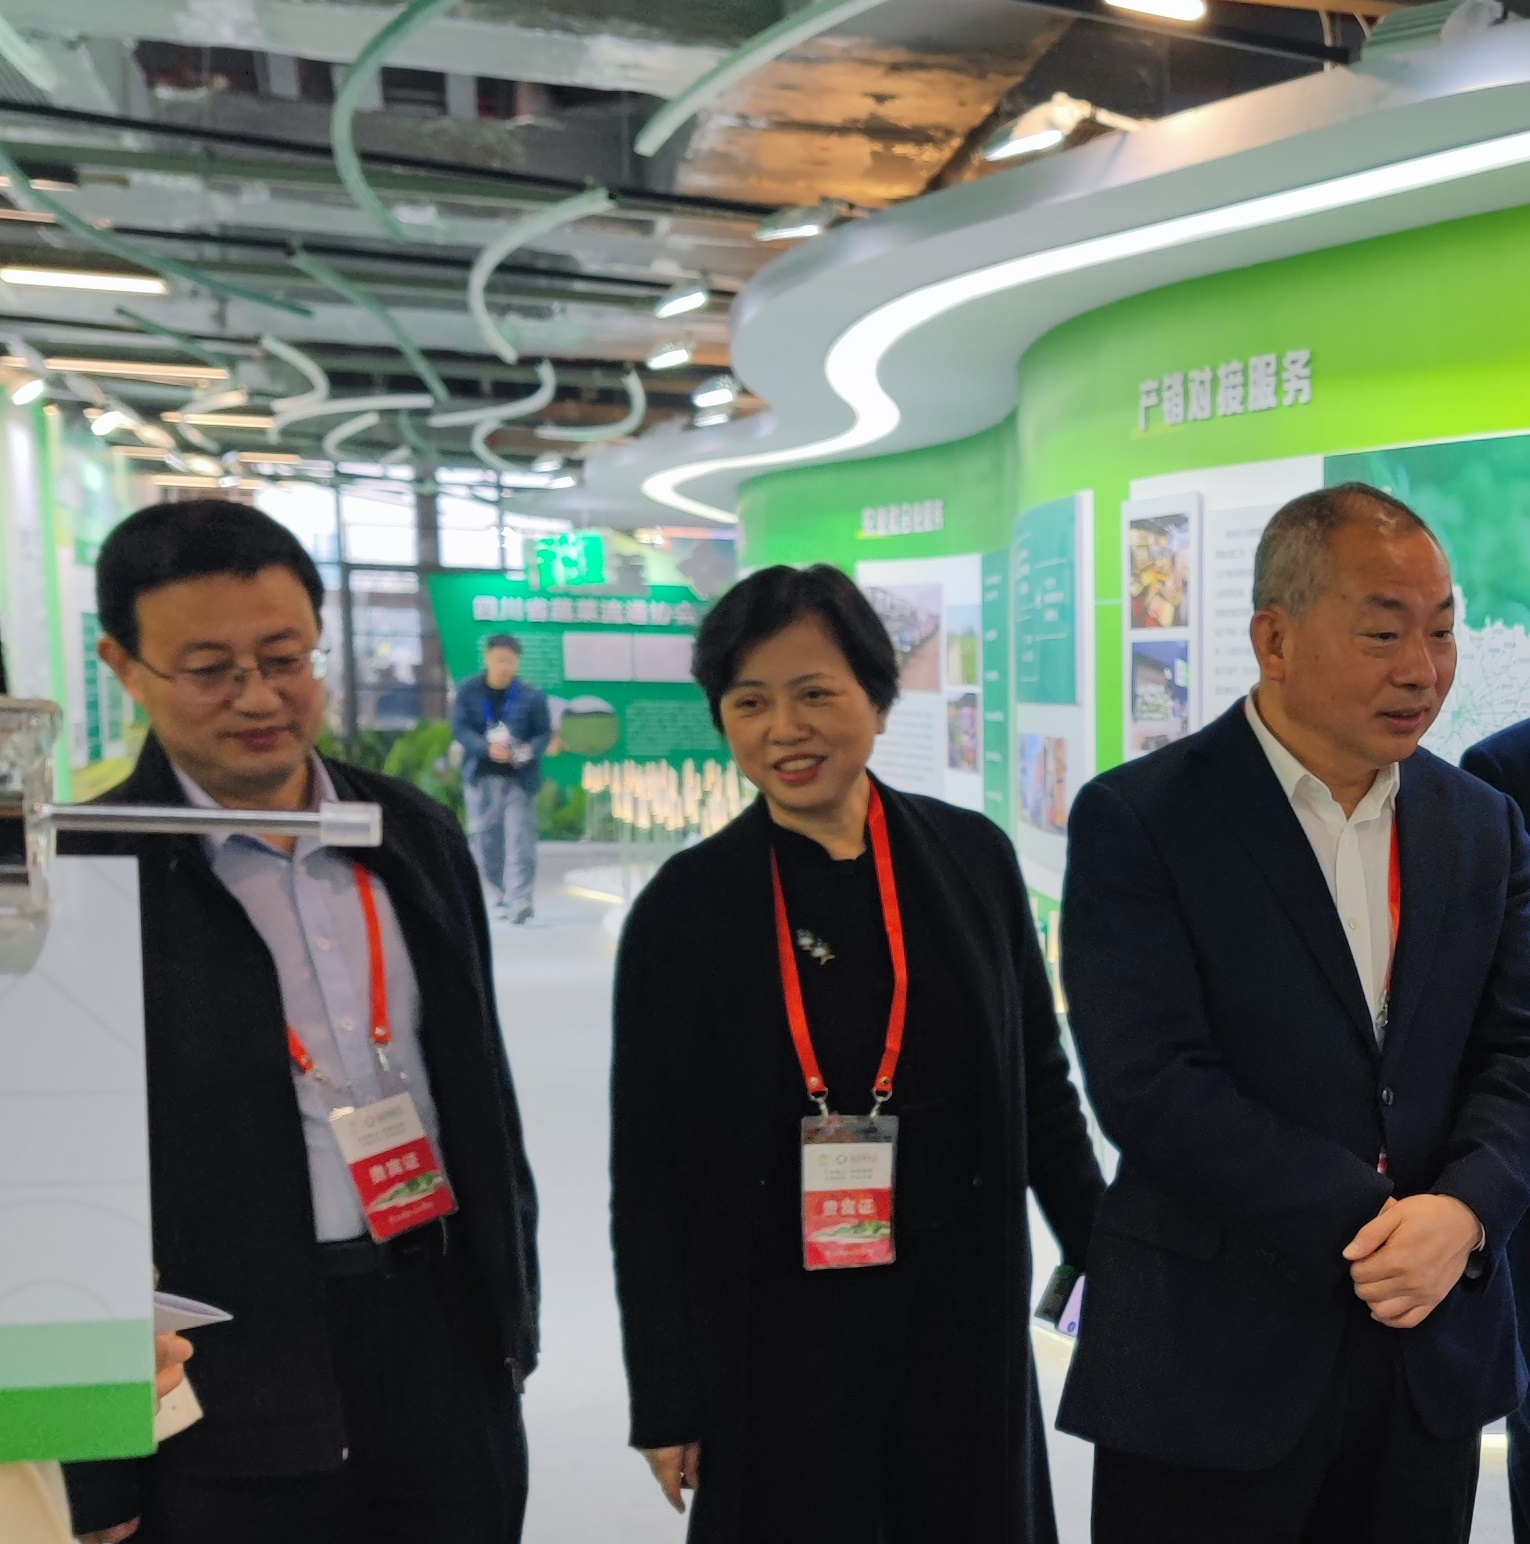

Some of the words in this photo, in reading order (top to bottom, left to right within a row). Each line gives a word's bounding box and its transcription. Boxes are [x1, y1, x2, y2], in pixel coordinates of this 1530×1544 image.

[1137, 348, 1313, 432] 产销对接服务
